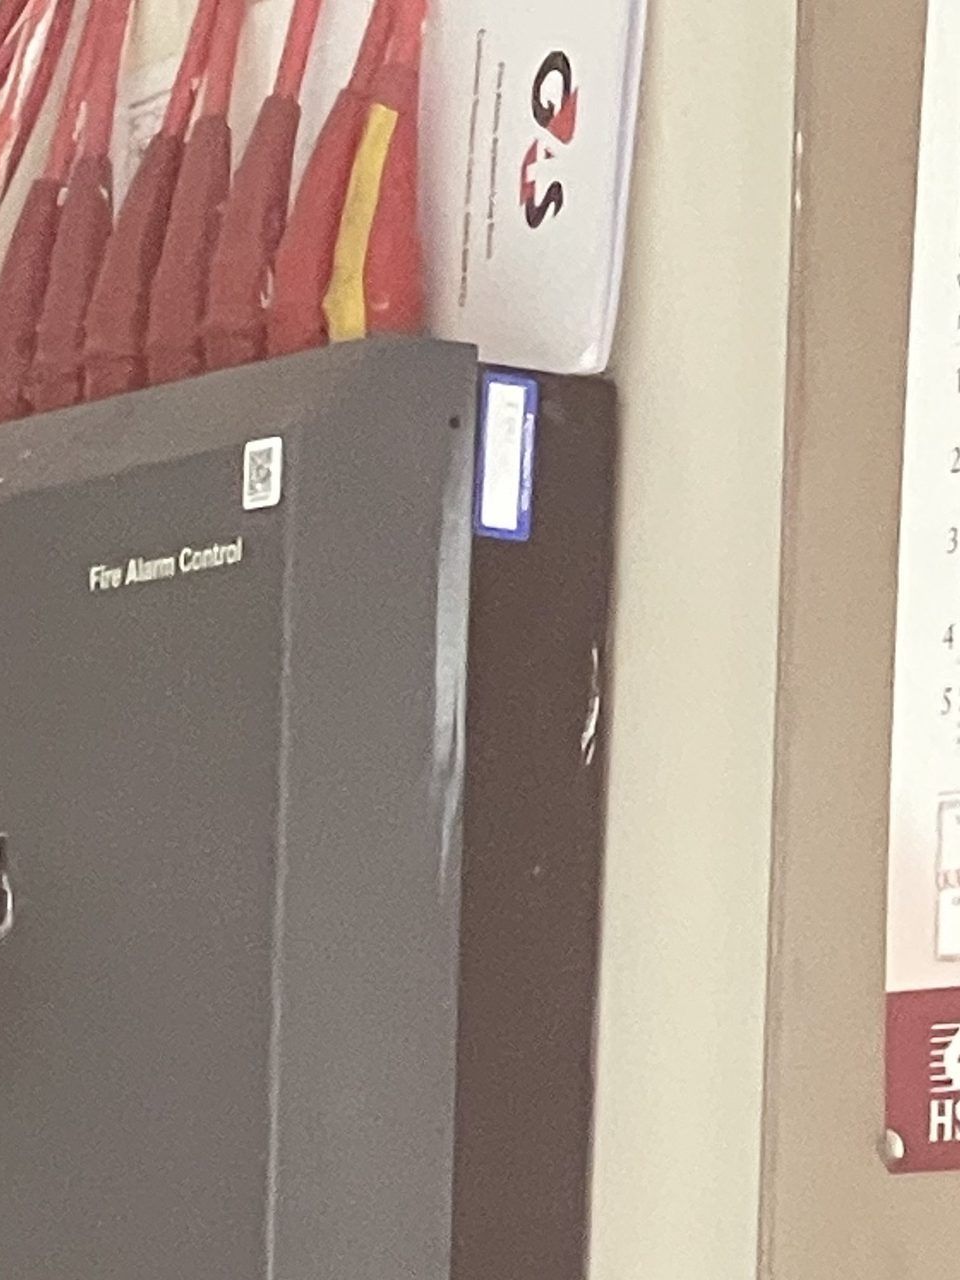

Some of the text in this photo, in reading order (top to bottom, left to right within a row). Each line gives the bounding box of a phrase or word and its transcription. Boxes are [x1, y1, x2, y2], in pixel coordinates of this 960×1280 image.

[519, 50, 578, 229] G4S
[946, 526, 959, 554] 3
[89, 536, 243, 592] Fire Alarm Control
[942, 623, 956, 650] 4
[940, 687, 953, 716] 5
